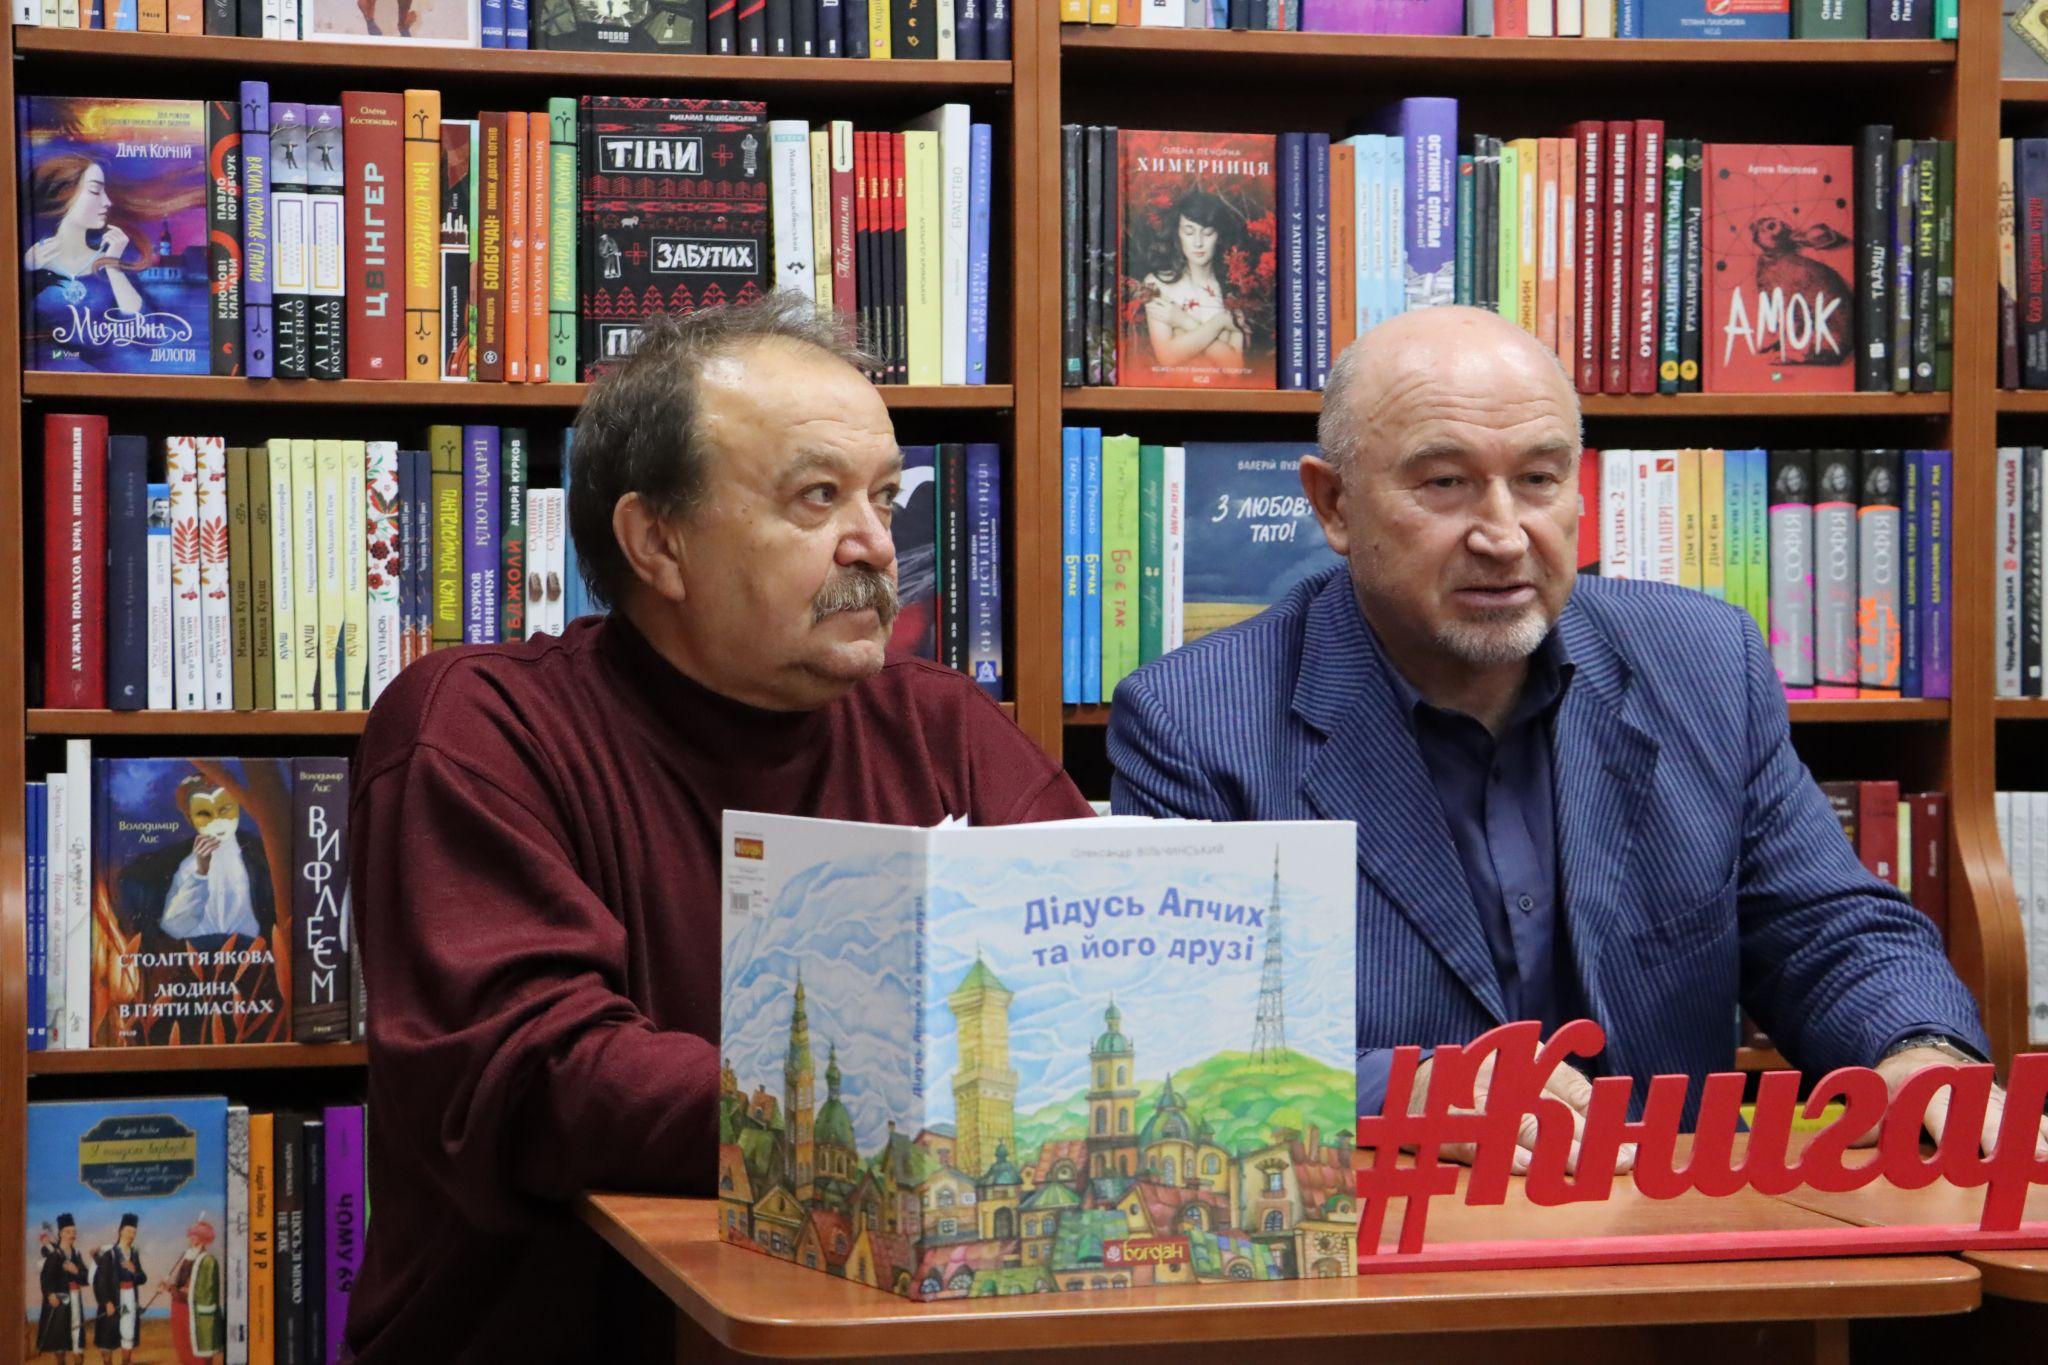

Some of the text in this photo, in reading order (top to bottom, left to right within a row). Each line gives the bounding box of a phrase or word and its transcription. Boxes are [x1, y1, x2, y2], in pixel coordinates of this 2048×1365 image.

[116, 142, 192, 159] ДАРА КОРНІЙ
[414, 162, 434, 186] ІВАН
[606, 140, 698, 172] ТІНИ
[1136, 157, 1270, 176] ХИМЕРНИЦЯ
[1162, 146, 1194, 156] ОЛЕНА
[217, 177, 227, 220] ПАВЛО
[228, 155, 238, 221] КОРОБЧУК
[554, 152, 572, 204] МИХАЙЛО
[952, 166, 962, 229] БРАТСТВО
[1428, 134, 1441, 248] ОСТАННЯ СПРАВА
[246, 156, 265, 282] ВАСИЛЬ КОРОЛІВ-СТАРИЙ
[364, 162, 388, 317] ЦВІНГЕР
[484, 215, 500, 290] БОЛБОЧАН:
[656, 243, 754, 270] ЗАБУТИХ
[1872, 246, 1886, 299] ТАДУШ
[218, 260, 228, 320] КЛЮЧОВІ
[229, 258, 239, 320] КЛАПАНИ
[1292, 212, 1302, 367] У ЗАТІНКУ ЗЕМНОЇ ЖІНКИ
[1316, 214, 1326, 368] У ЗАТІНКУ ЗЕМНОЇ ЖІНКИ
[53, 304, 193, 348] Місяцівна
[280, 301, 293, 370] ЛІНА
[296, 300, 304, 372] КОСТЕНКО
[315, 301, 329, 370] ЛІНА
[330, 300, 340, 373] КОСТЕНКО
[1640, 290, 1653, 358] ОТАМАН
[1724, 286, 1842, 367] АМОК
[150, 348, 196, 362] ДИЛОГІЯ
[510, 440, 520, 526] АНДРІЙ КУРКОВ
[1238, 460, 1300, 470] ВАЛЕРІЙ ПУЗІ
[2006, 459, 2017, 507] ЧАПАЙ
[474, 439, 490, 546] КЛЮЧІ МАРІЇ
[1212, 494, 1312, 522] З ЛЮБОВ'
[528, 497, 538, 552] САДІВНИК
[546, 496, 554, 551] САДІВНИК
[1250, 522, 1296, 542] ТАТО!
[1658, 505, 1675, 575] НА ПАПЕРІ
[440, 489, 458, 621] ПАНТЕЛЕЙМОН КУЛІШ
[1066, 554, 1080, 596] БУРЧАК
[1085, 554, 1100, 595] БУРЧАК
[72, 556, 82, 620] ПОМАХОМ
[470, 572, 482, 644] РІЙ КУРКОВ
[507, 540, 522, 628] БДЖОЛИ
[1111, 550, 1132, 628] БО Є ТАК
[236, 580, 246, 658] Микола Куліш
[258, 580, 268, 658] Микола Куліш
[304, 624, 315, 659] КУЛІШ
[346, 622, 358, 658] КУЛІШ
[300, 772, 344, 782] Володимир
[312, 783, 332, 792] Лис
[118, 820, 180, 831] Володимир
[138, 834, 160, 844] Лис
[1024, 886, 1266, 934] Дідусь Апчих
[118, 950, 275, 968] СТОЛІТТЯ ЯКОВА
[1032, 934, 1255, 968] та його друзі
[119, 999, 274, 1018] В П'ЯТИ МАСКАХ
[154, 981, 239, 998] ЛЮДИНА
[254, 1232, 268, 1269] МУР
[278, 1212, 288, 1252] НЕ ТАК
[291, 1210, 302, 1248] ЩОСЬ
[336, 1194, 353, 1263] ЧОМУ
[291, 1264, 302, 1304] МНОЮ
